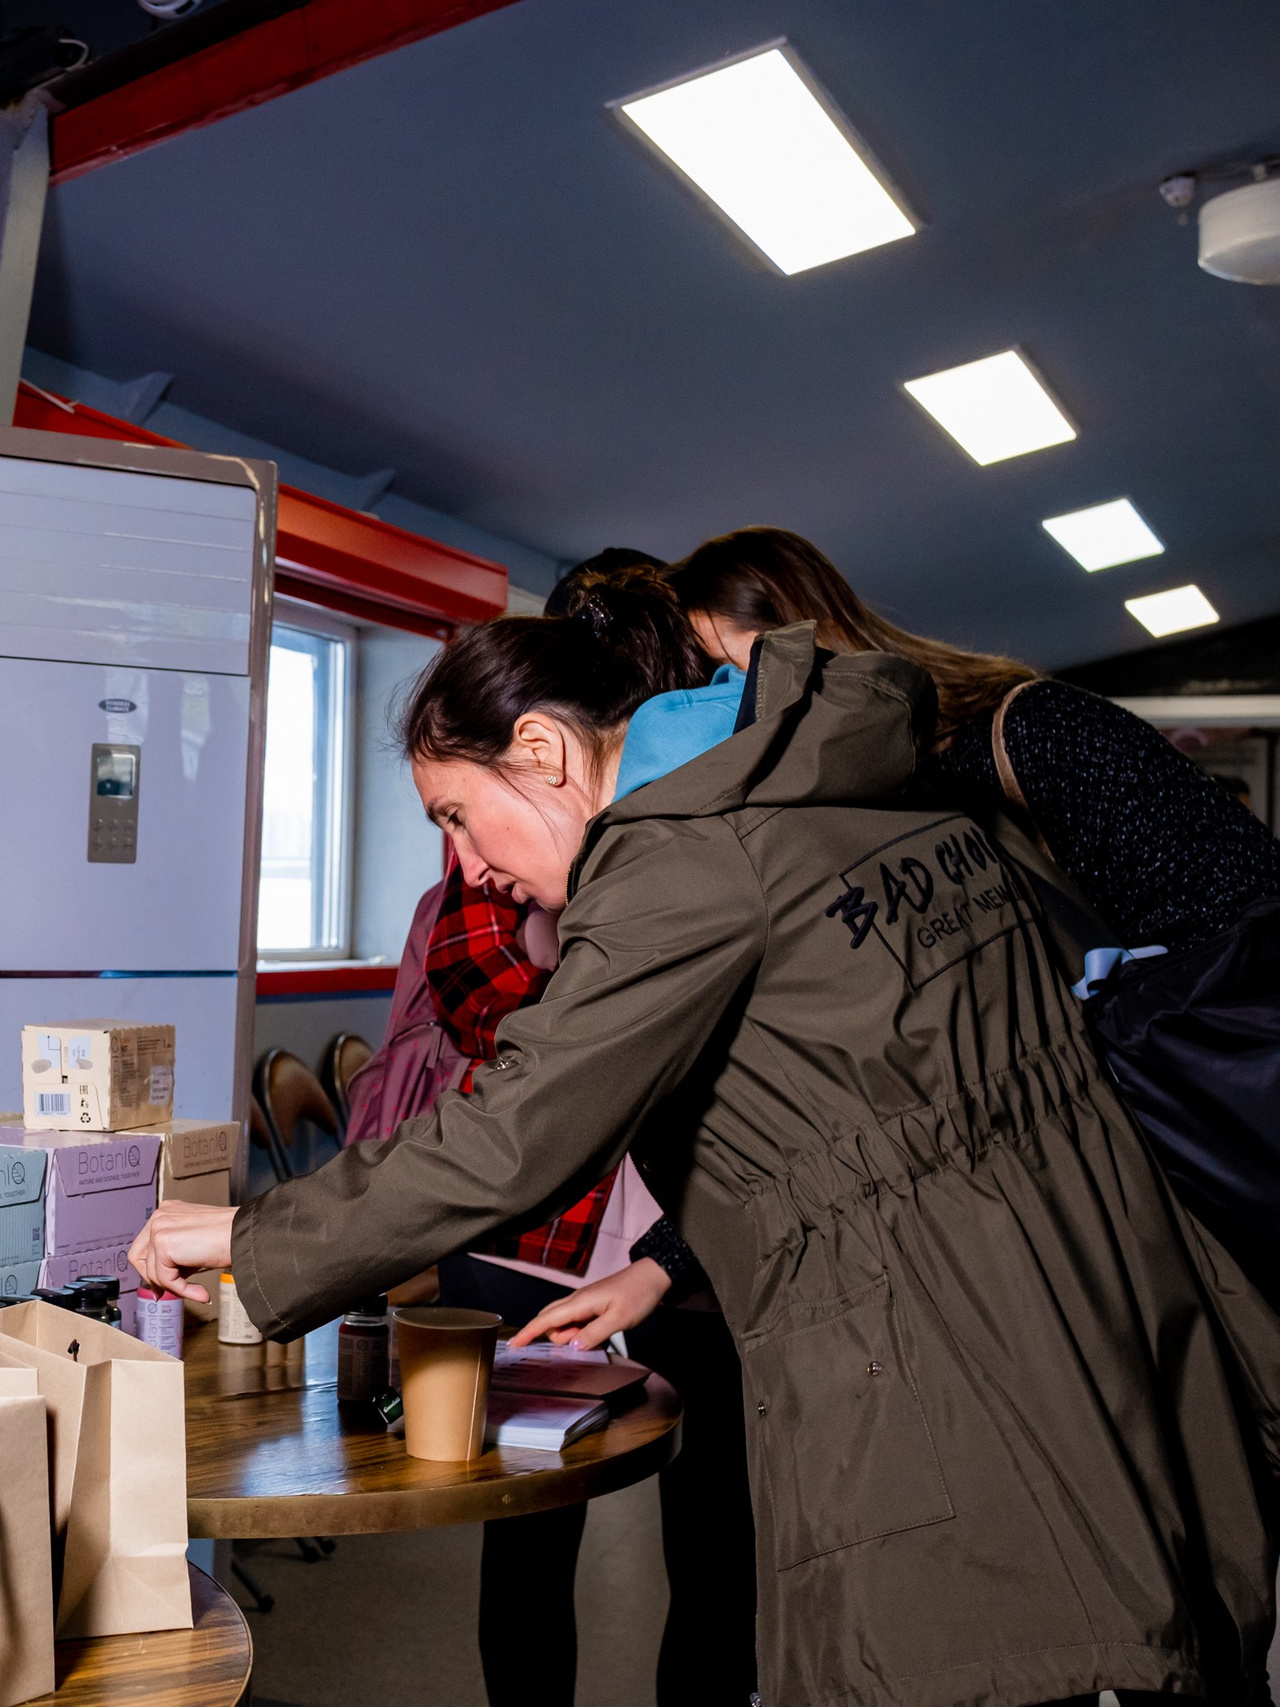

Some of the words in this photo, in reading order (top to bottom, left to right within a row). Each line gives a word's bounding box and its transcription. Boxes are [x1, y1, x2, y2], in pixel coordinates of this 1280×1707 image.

[825, 857, 934, 949] BAD
[916, 902, 974, 949] GREAT
[79, 1145, 141, 1175] BotanIQ
[147, 1302, 158, 1348] otanIQ
